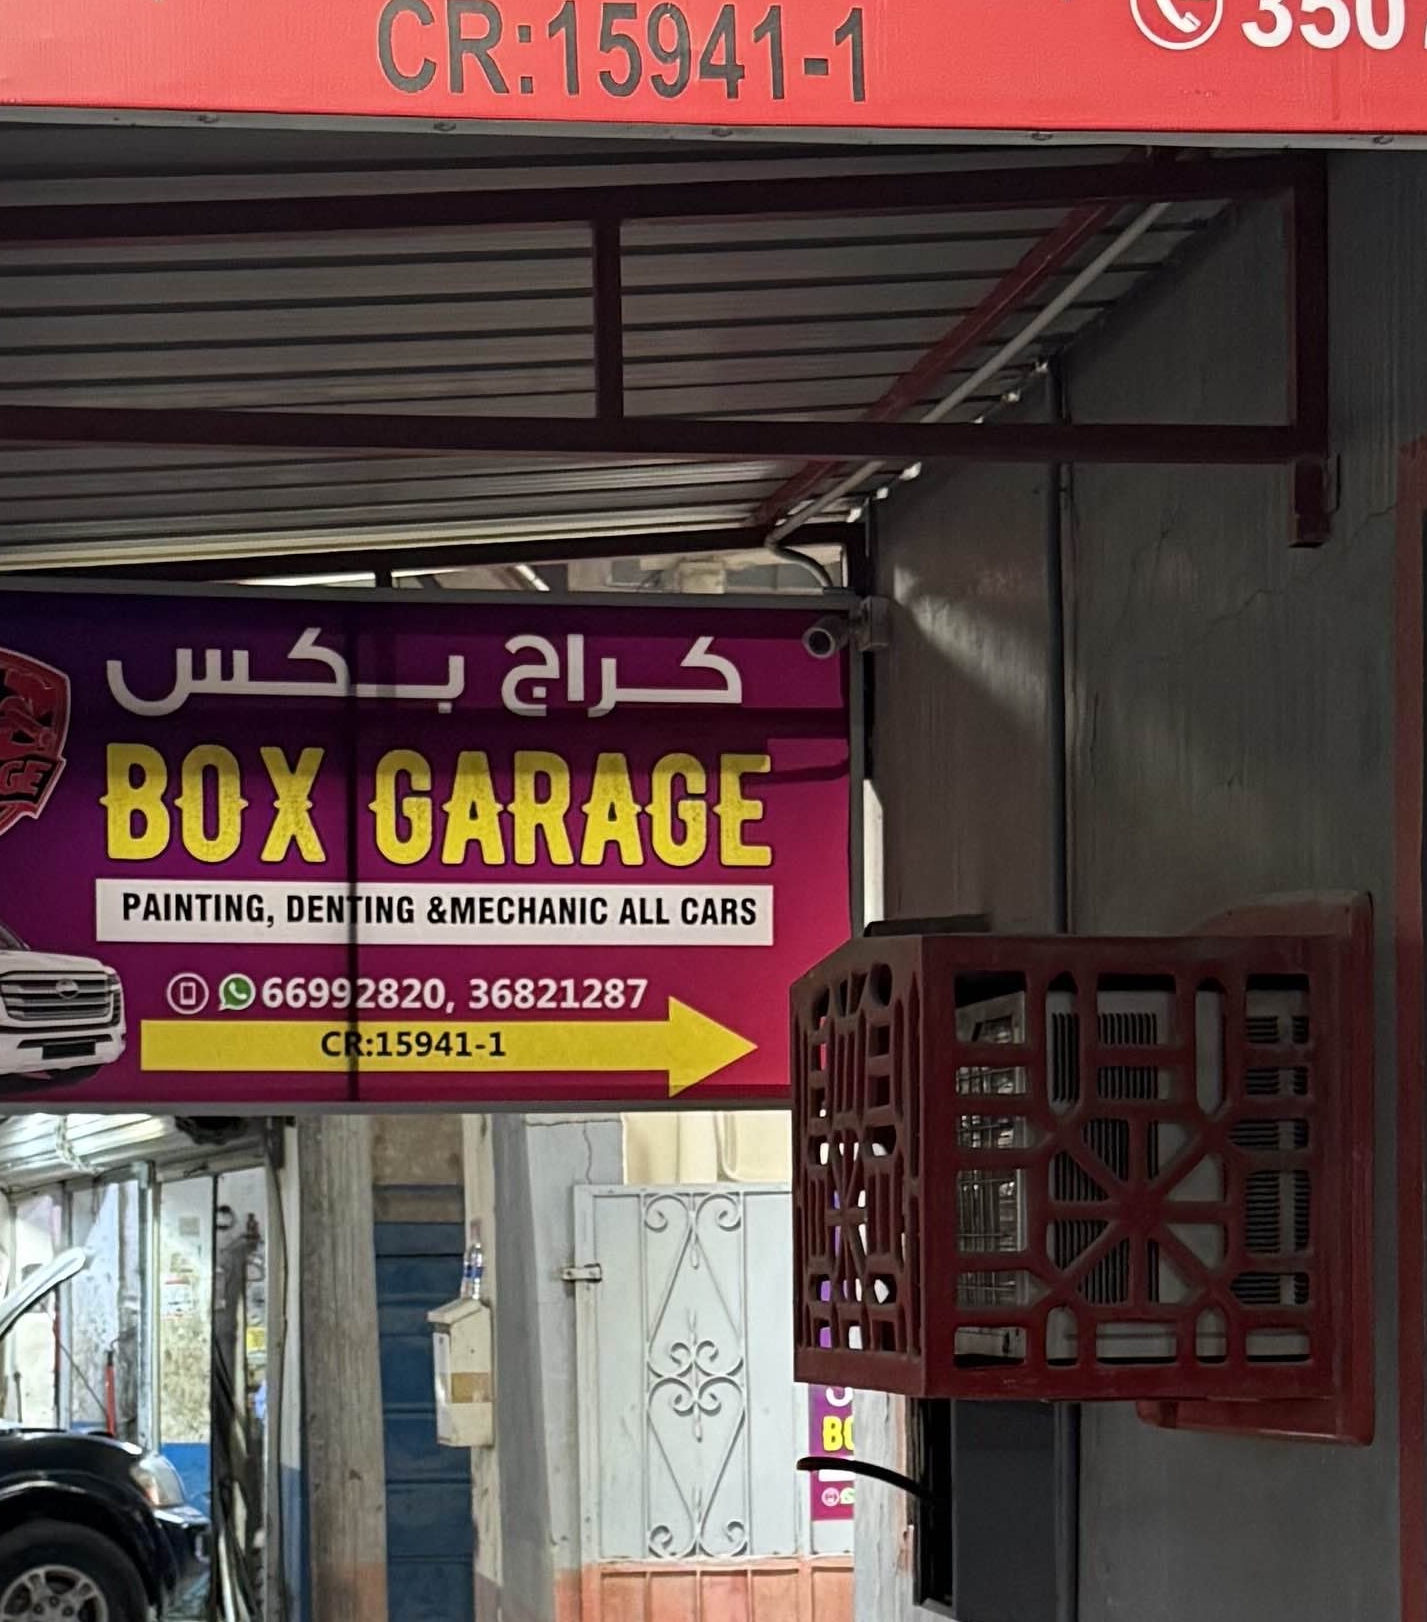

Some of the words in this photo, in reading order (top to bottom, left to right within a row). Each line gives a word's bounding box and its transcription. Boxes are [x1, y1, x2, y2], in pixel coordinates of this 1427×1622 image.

[502, 634, 742, 716] كراج
[100, 743, 325, 862] BOX
[368, 749, 771, 866] GARAGE
[123, 893, 274, 927] PAINTING,
[287, 894, 413, 924] DENTING
[427, 896, 608, 925] &MECHANIC
[619, 897, 670, 925] ALL
[681, 898, 756, 925] CARS
[262, 978, 455, 1015] 66992820,
[469, 978, 648, 1010] 36821287
[321, 1030, 506, 1058] CR:15941-1
